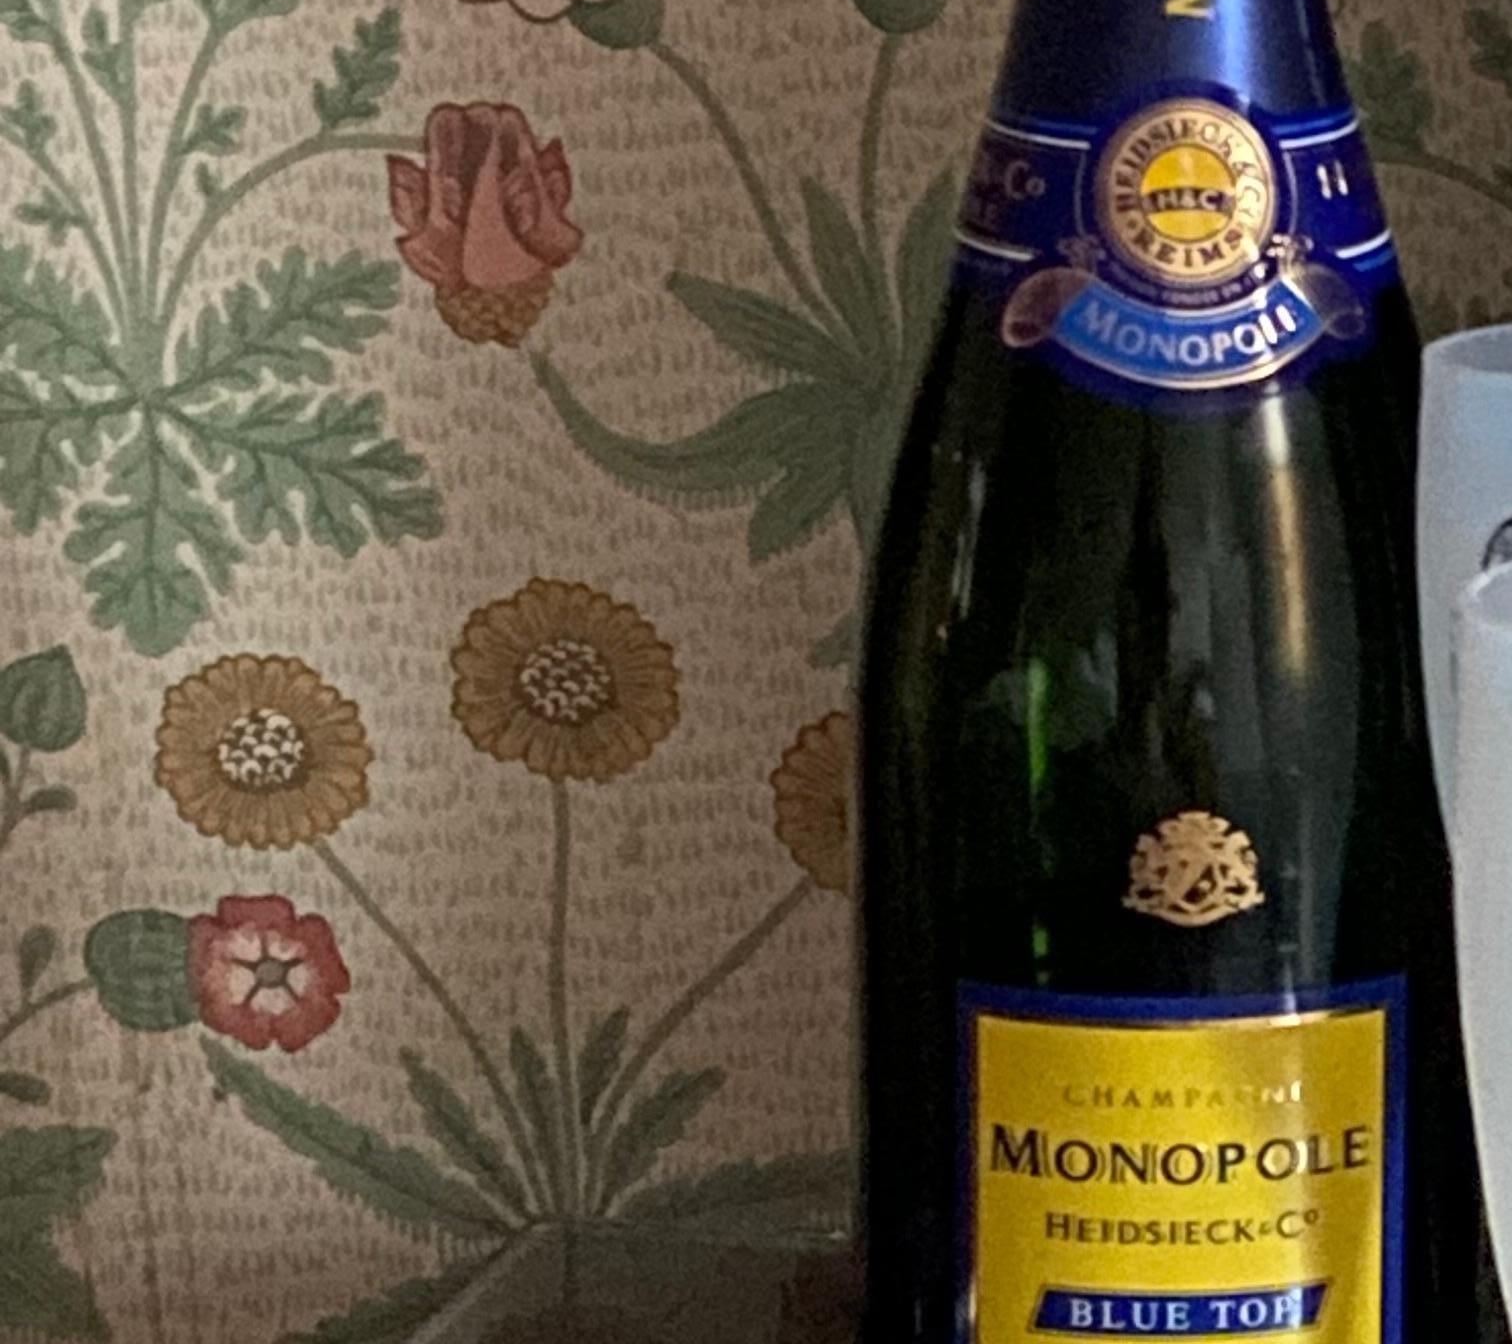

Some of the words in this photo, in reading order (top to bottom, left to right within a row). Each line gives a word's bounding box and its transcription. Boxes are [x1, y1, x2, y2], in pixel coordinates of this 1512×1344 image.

[990, 1123, 1371, 1186] MONOPOLE
[1045, 1211, 1256, 1246] HEIDSIECK
[1069, 1297, 1191, 1331] BLUE
[1208, 1292, 1302, 1328] TOP
